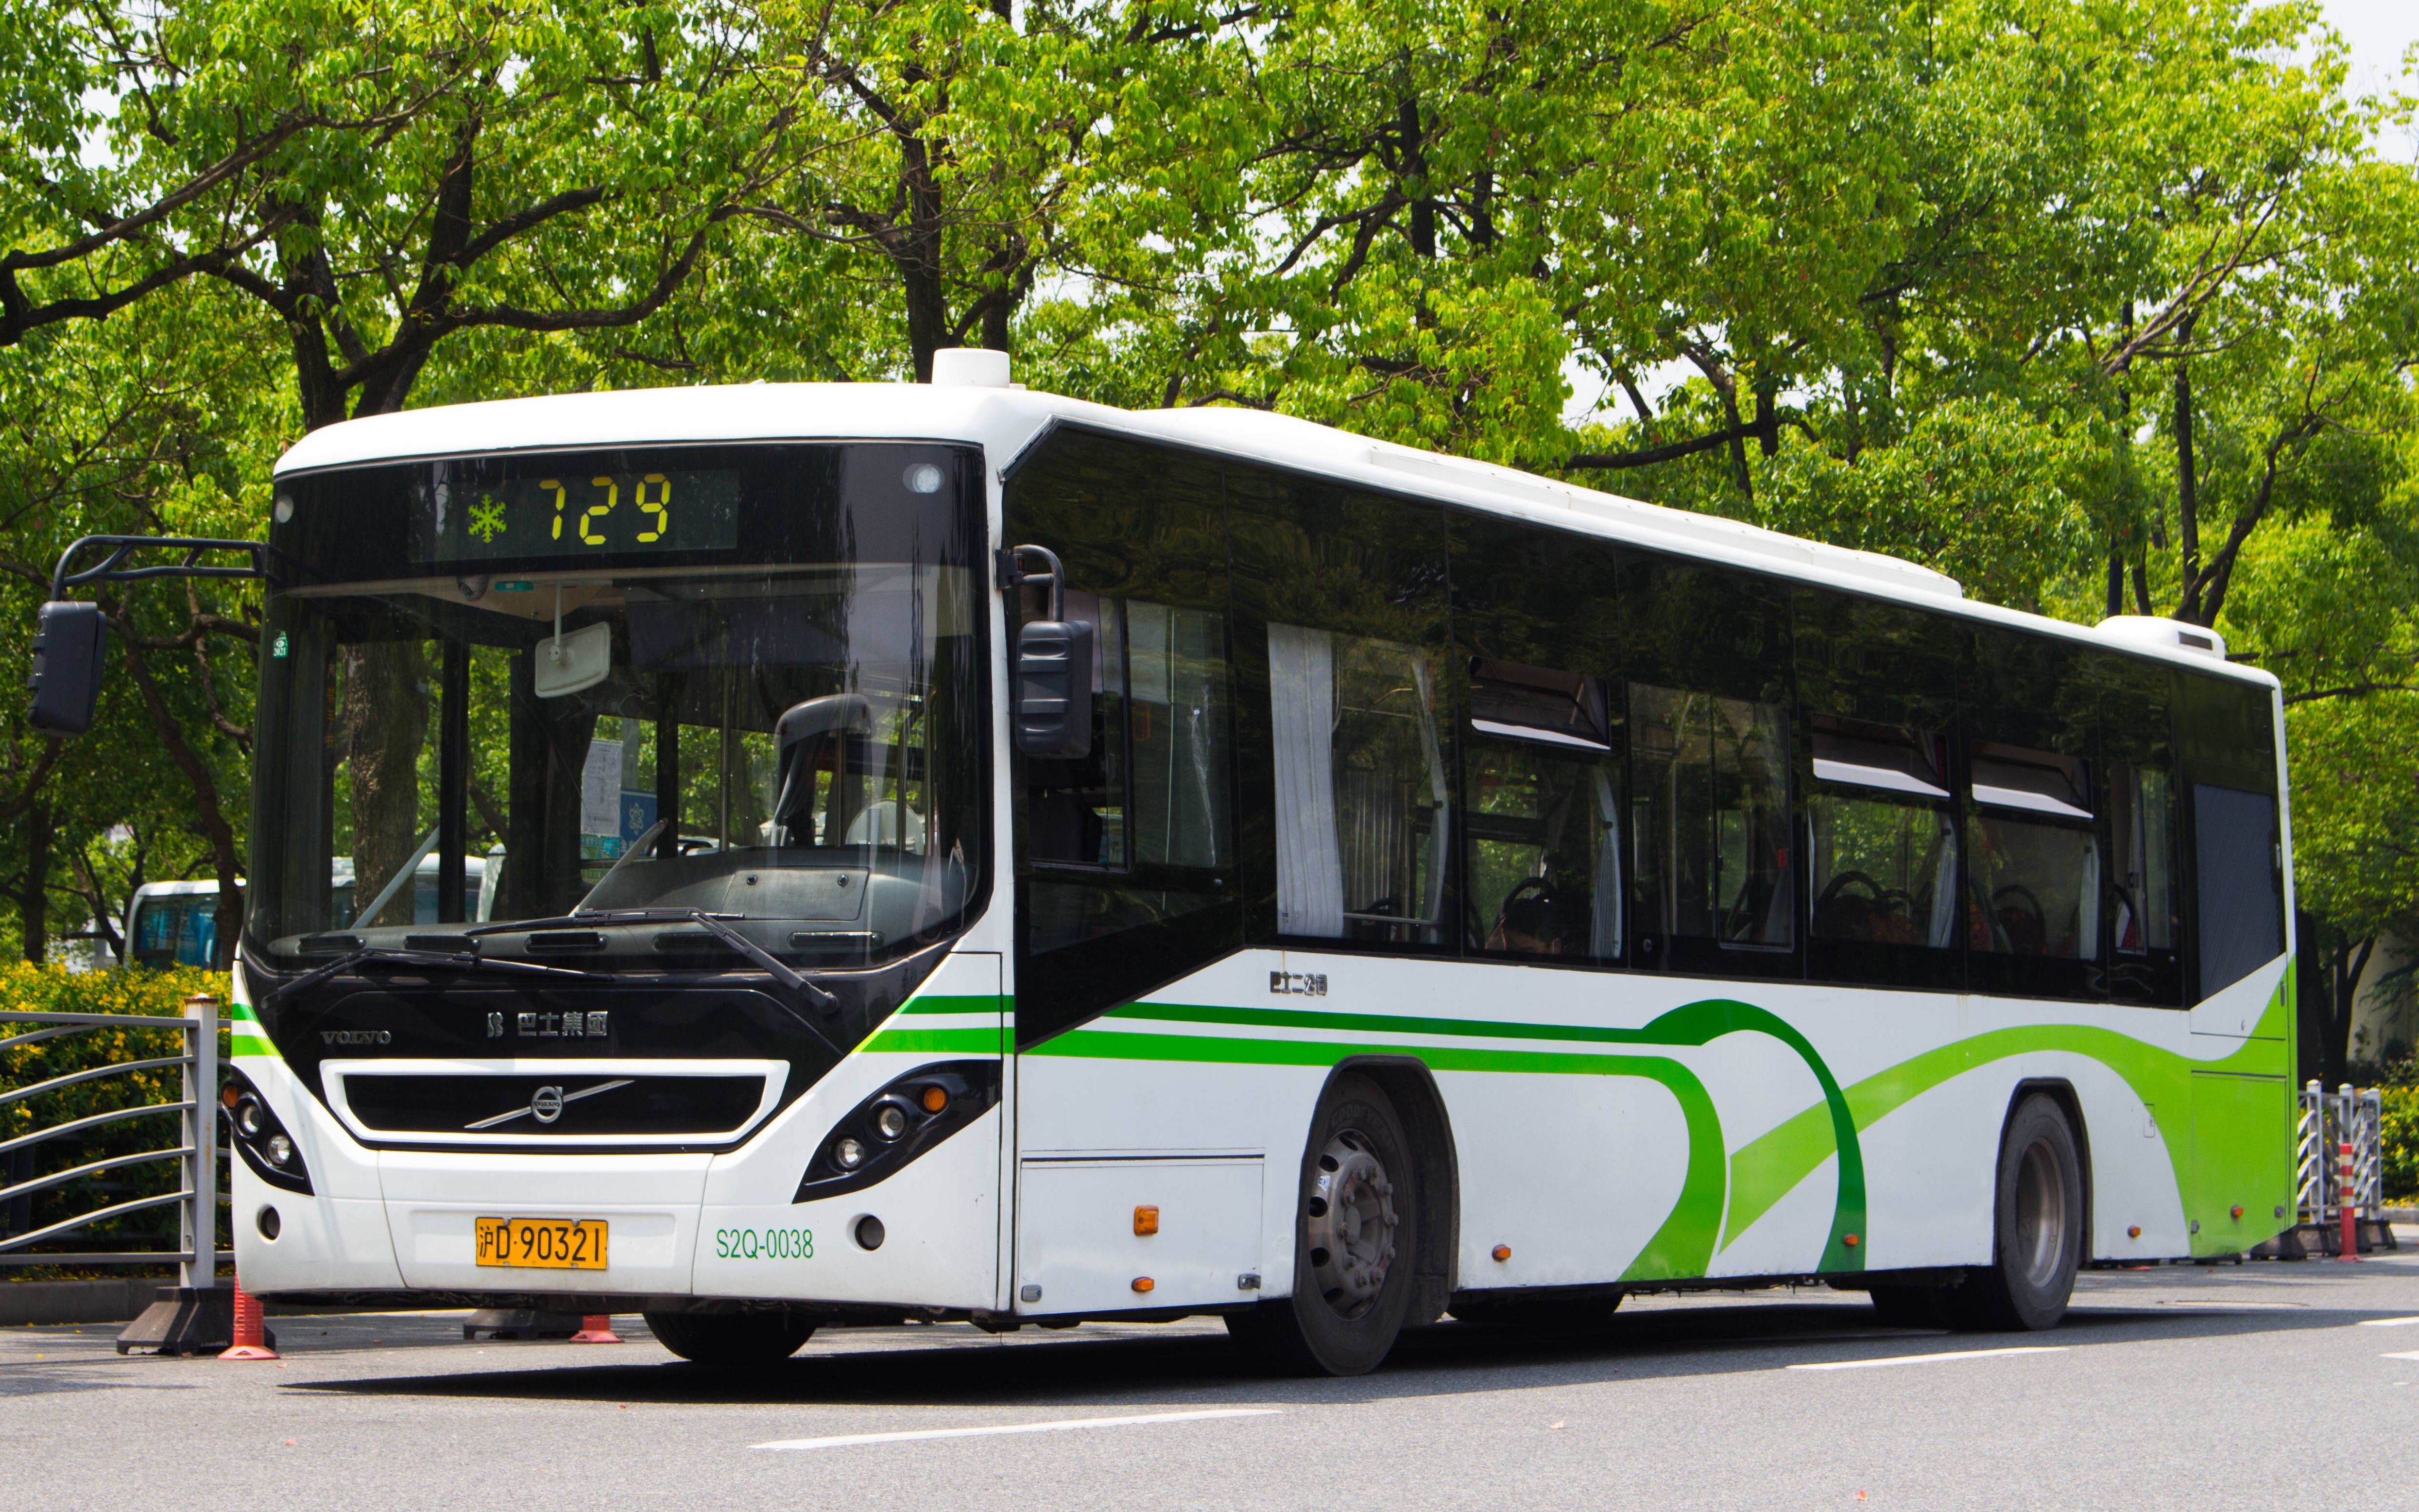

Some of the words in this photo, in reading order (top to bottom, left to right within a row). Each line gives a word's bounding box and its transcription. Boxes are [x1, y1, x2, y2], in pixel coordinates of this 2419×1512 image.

[539, 473, 671, 545] 729
[273, 647, 286, 656] 2021
[320, 1031, 392, 1044] VOLVO
[717, 1229, 813, 1259] S2Q-0038
